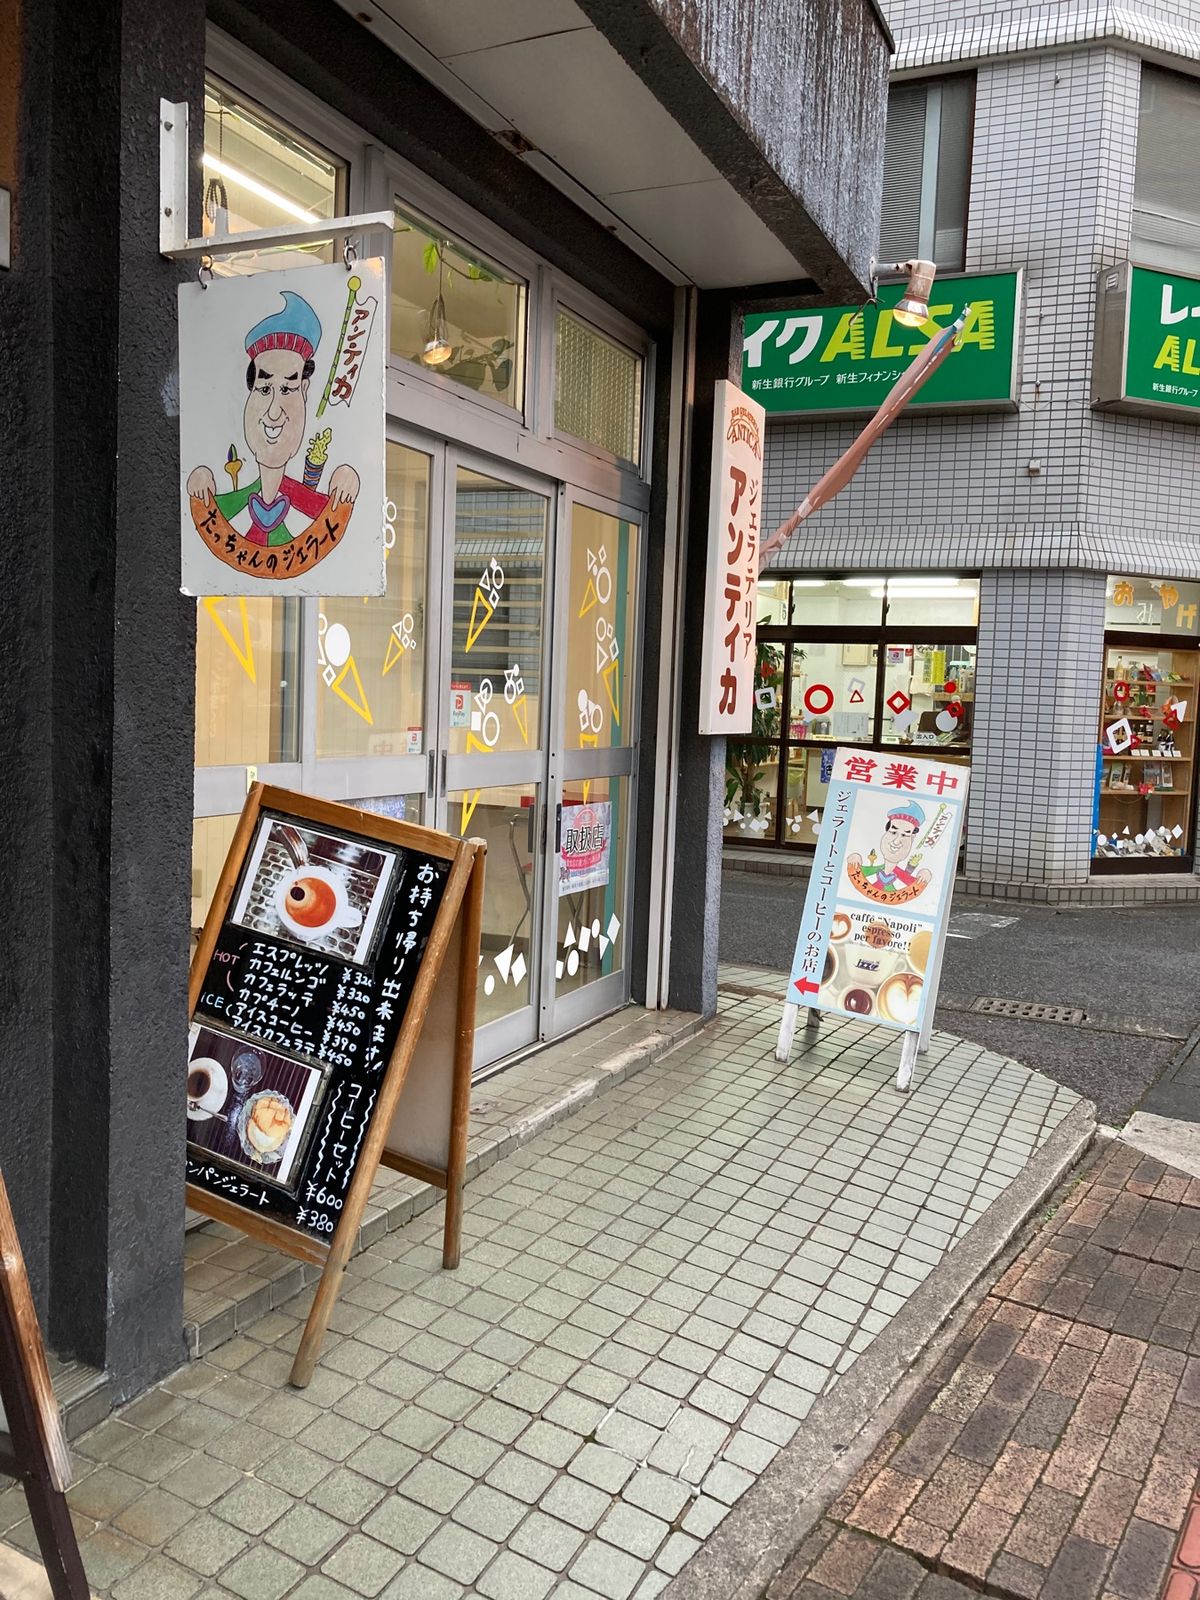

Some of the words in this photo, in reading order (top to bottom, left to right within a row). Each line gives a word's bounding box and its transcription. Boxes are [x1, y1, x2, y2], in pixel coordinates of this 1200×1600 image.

[1160, 284, 1200, 325] レ
[332, 309, 369, 400] アンティカ
[751, 374, 830, 390] 新生銀行グループ
[836, 370, 905, 384] 新生フィナンシ
[200, 508, 341, 572] たっちゃんのジェラート
[718, 465, 747, 716] アンティカ
[743, 478, 759, 660] ジェラテリア
[844, 756, 959, 795] 営業中
[565, 823, 606, 855] 取扱店
[801, 790, 852, 974] ジェラートとコーヒーのお店
[851, 870, 920, 902] たっちゃんのジェラート
[854, 932, 871, 942] per
[861, 924, 902, 940] espresso
[213, 949, 240, 965] HOT
[249, 957, 327, 989] カフェルンゴ
[336, 983, 370, 1004] ¥320
[243, 973, 313, 1007] カフェラッテ
[331, 1000, 366, 1020] ¥450
[231, 1014, 316, 1055] アイスカフェラテ
[318, 1043, 353, 1067] ¥450
[235, 1002, 313, 1036] アイスコーヒー
[322, 1029, 357, 1052] ¥390
[326, 1015, 361, 1036] ¥450
[326, 1083, 363, 1182] コーヒーセット
[185, 1159, 270, 1206] ンパンジェラート
[296, 1205, 334, 1232] ¥380
[305, 1180, 343, 1210] ¥600
